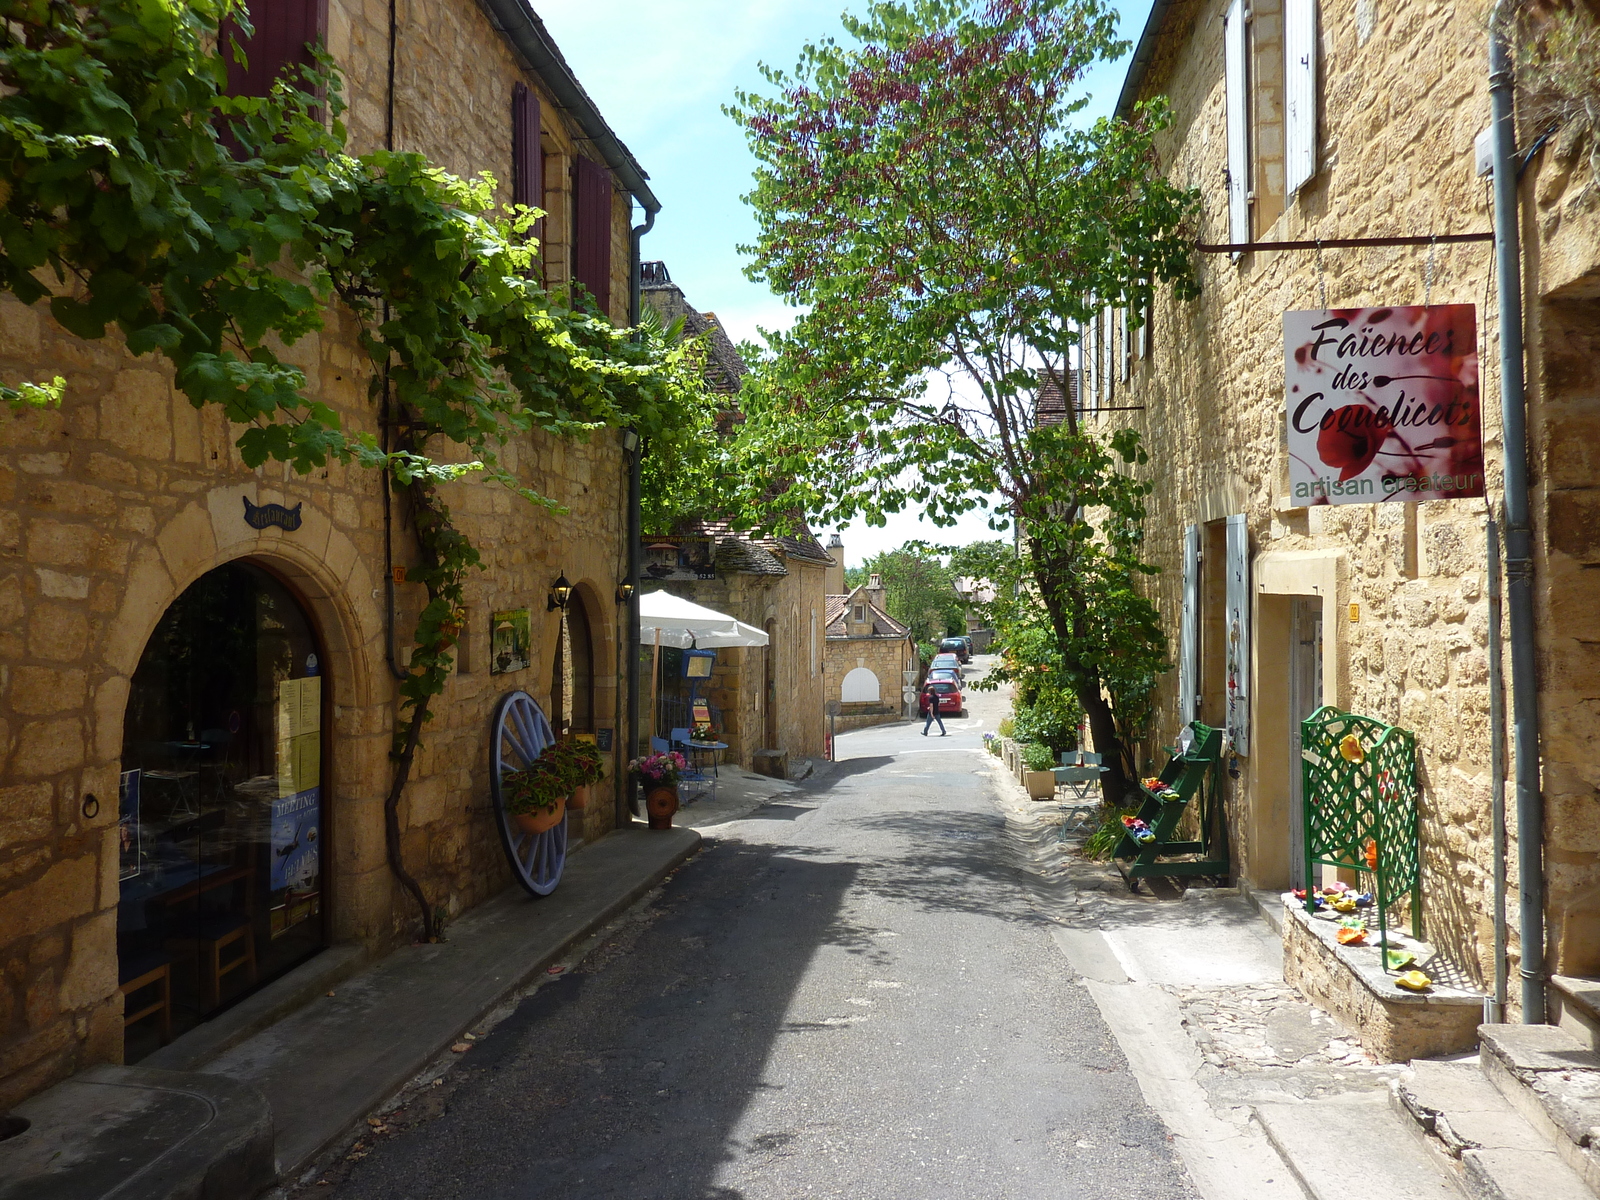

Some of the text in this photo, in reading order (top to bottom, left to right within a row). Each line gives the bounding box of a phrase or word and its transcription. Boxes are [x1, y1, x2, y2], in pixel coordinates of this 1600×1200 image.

[1310, 318, 1455, 361] Faïences
[1331, 363, 1373, 390] des
[1295, 472, 1478, 498] artisan créateur
[252, 508, 296, 528] Restaurant
[276, 793, 316, 818] MEETING
